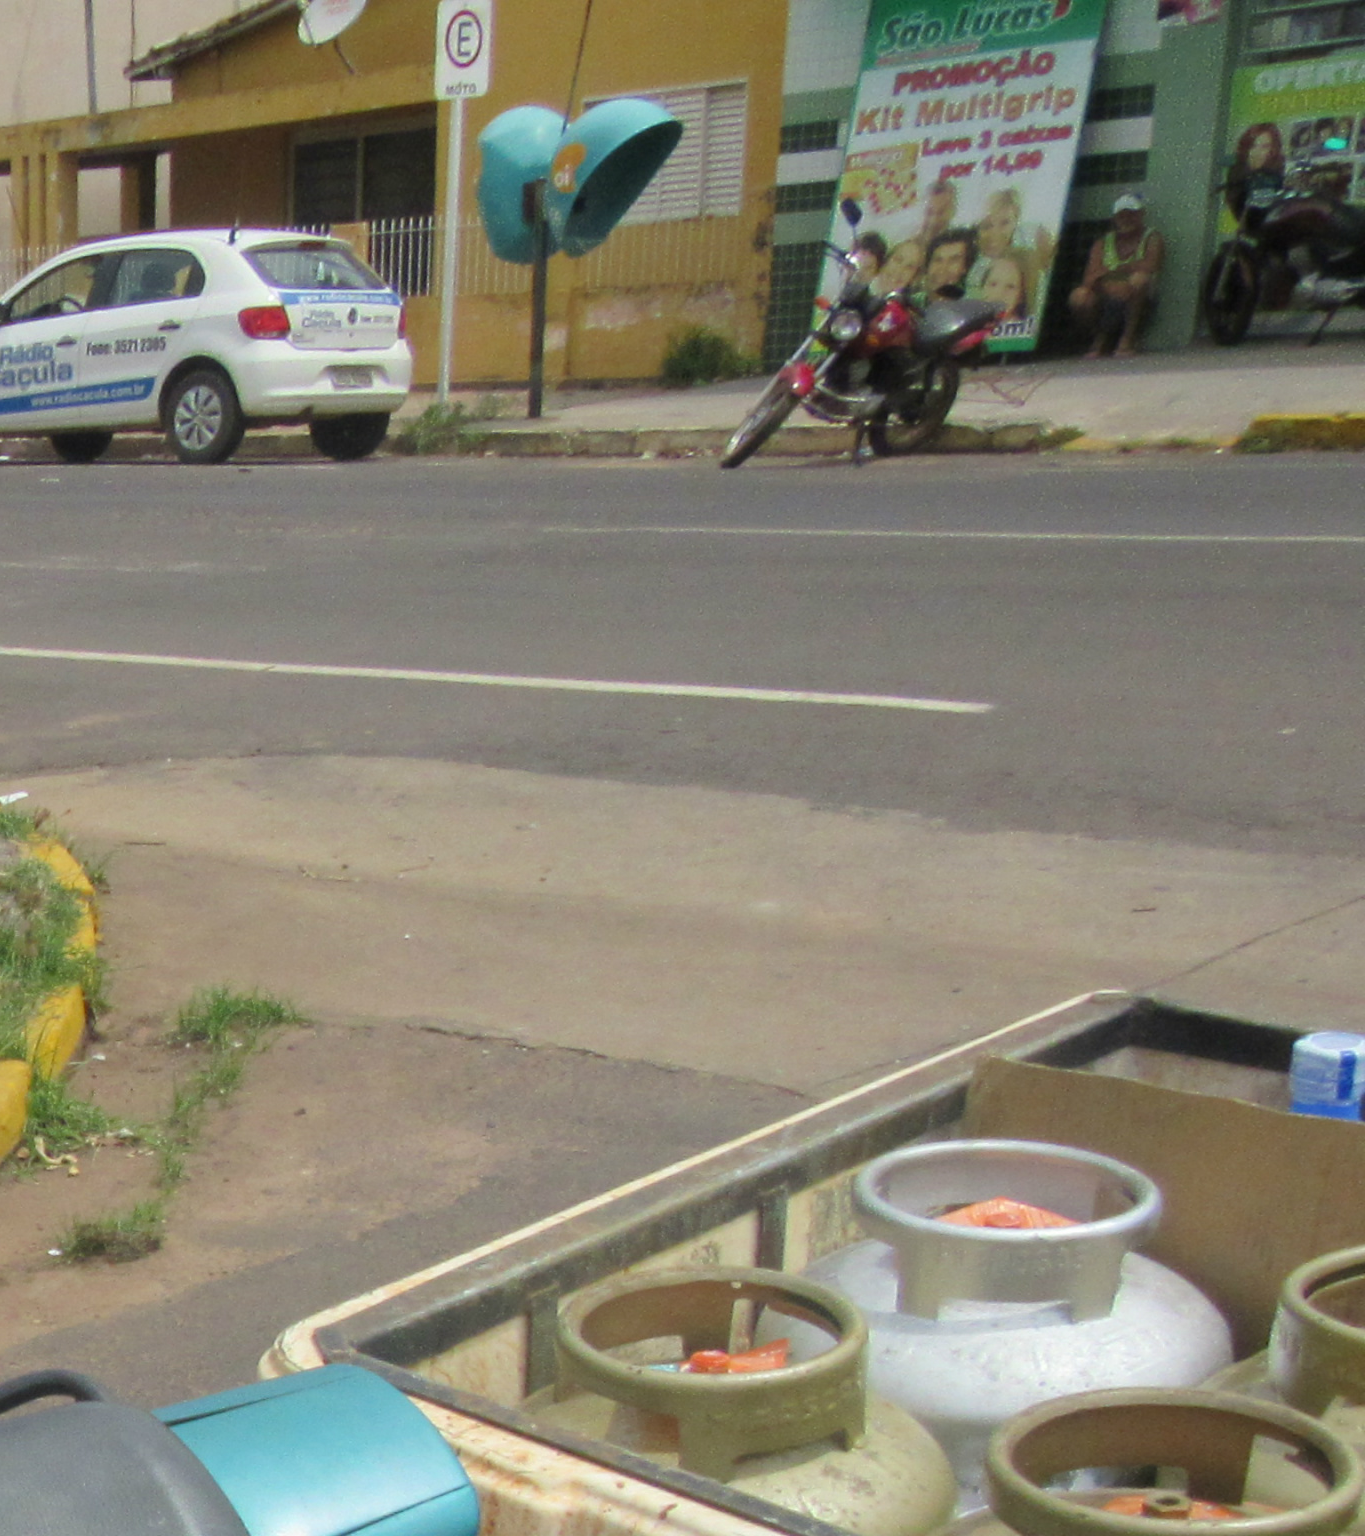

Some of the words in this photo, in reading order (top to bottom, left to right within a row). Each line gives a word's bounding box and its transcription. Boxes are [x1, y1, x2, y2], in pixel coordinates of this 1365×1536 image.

[457, 21, 472, 57] E
[877, 10, 944, 52] São
[950, 2, 1054, 41] Lucas
[893, 49, 1055, 96] PROMOÇÃO
[855, 105, 904, 135] Kit
[914, 85, 1076, 127] Multigrip
[554, 165, 570, 188] oi
[0, 342, 54, 365] Rádio
